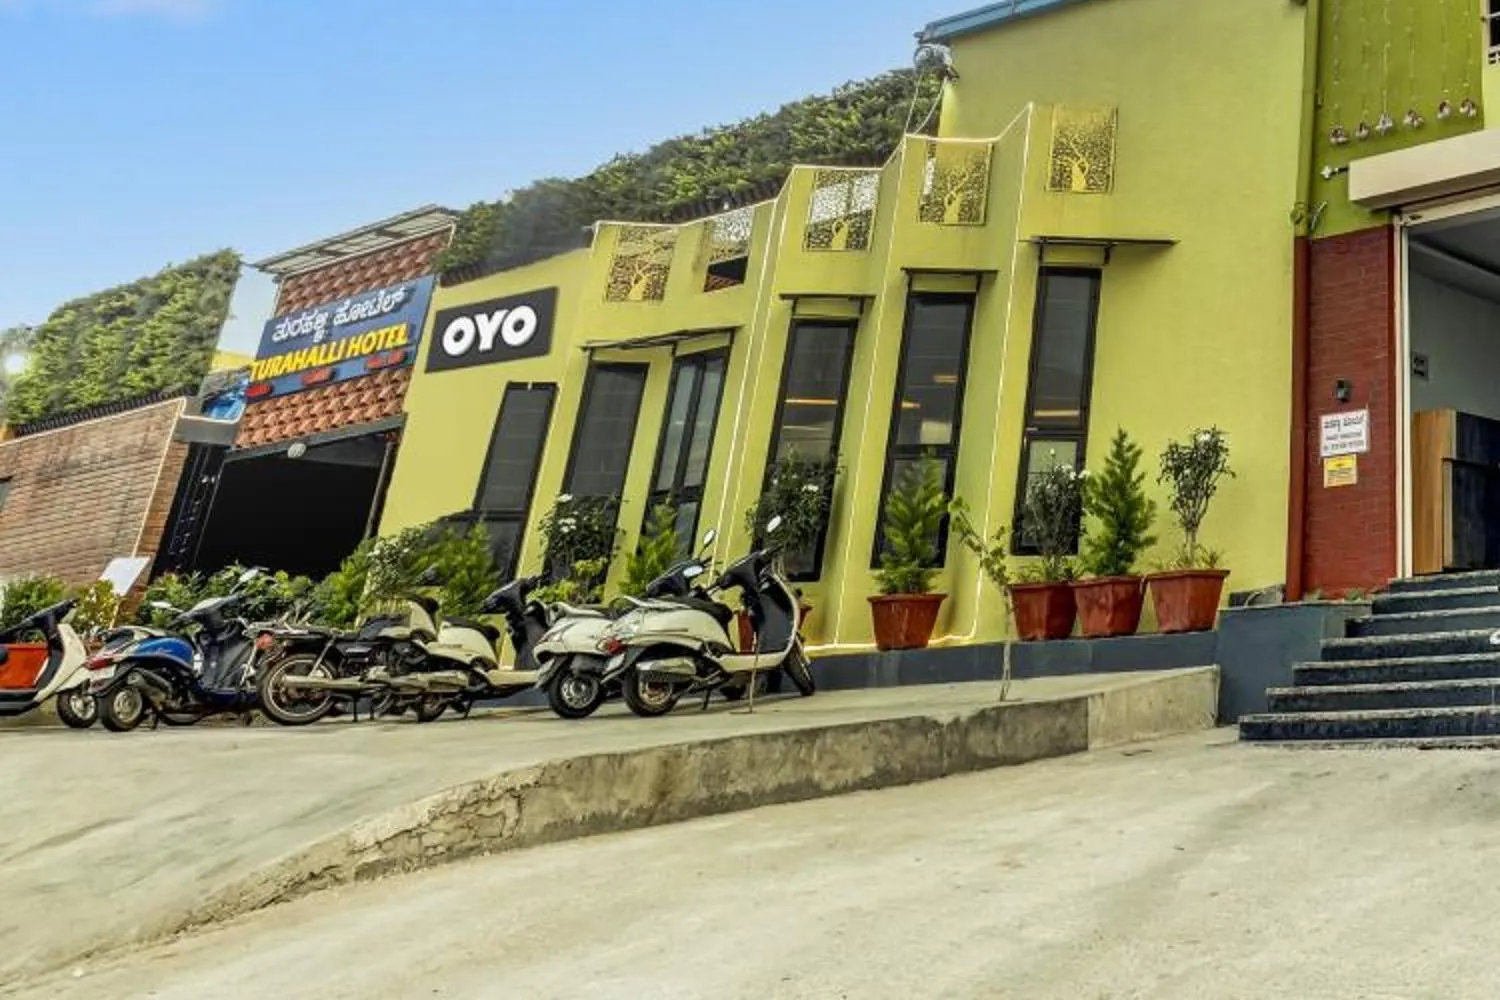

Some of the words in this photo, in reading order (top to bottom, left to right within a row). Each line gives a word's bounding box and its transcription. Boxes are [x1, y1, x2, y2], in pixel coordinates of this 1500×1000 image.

[250, 336, 347, 382] TURAHALLI
[346, 322, 408, 358] HOTEL
[442, 304, 538, 356] OYO
